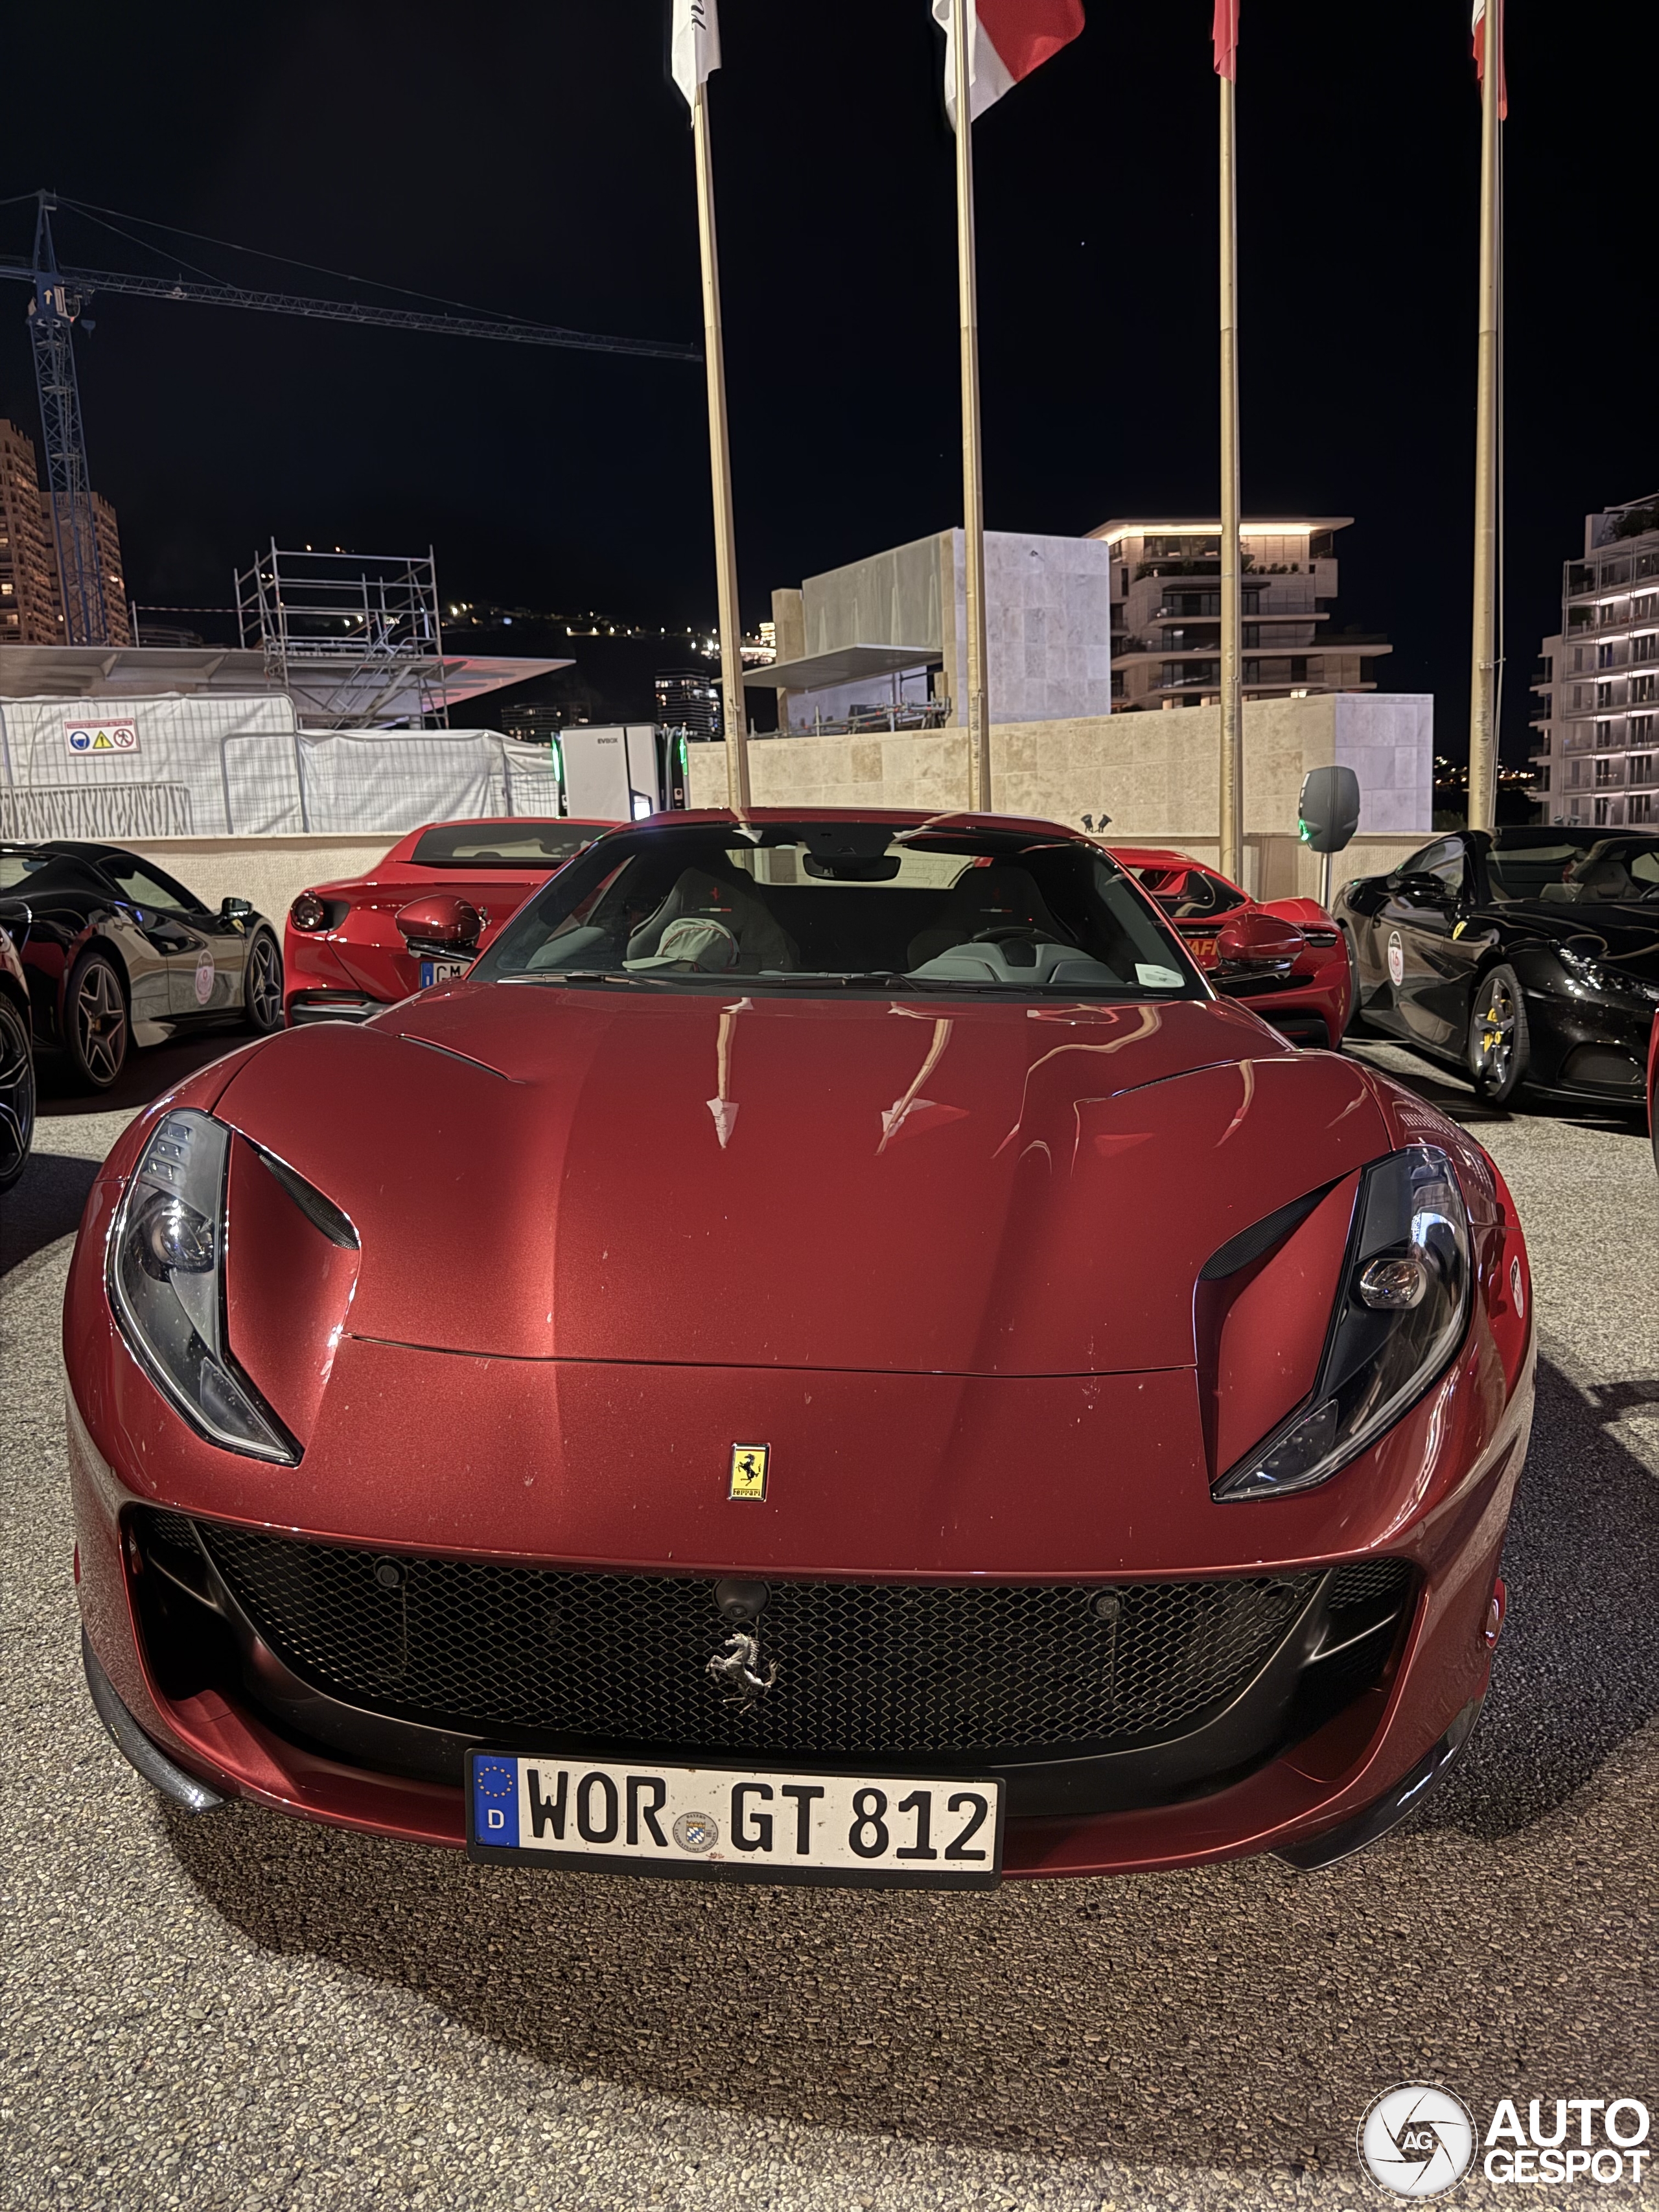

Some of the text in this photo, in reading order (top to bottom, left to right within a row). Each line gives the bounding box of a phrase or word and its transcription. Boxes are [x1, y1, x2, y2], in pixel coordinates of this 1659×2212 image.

[733, 1488, 761, 1496] Ferrari
[488, 1809, 504, 1829] D
[527, 1769, 988, 1861] WOR GT 812
